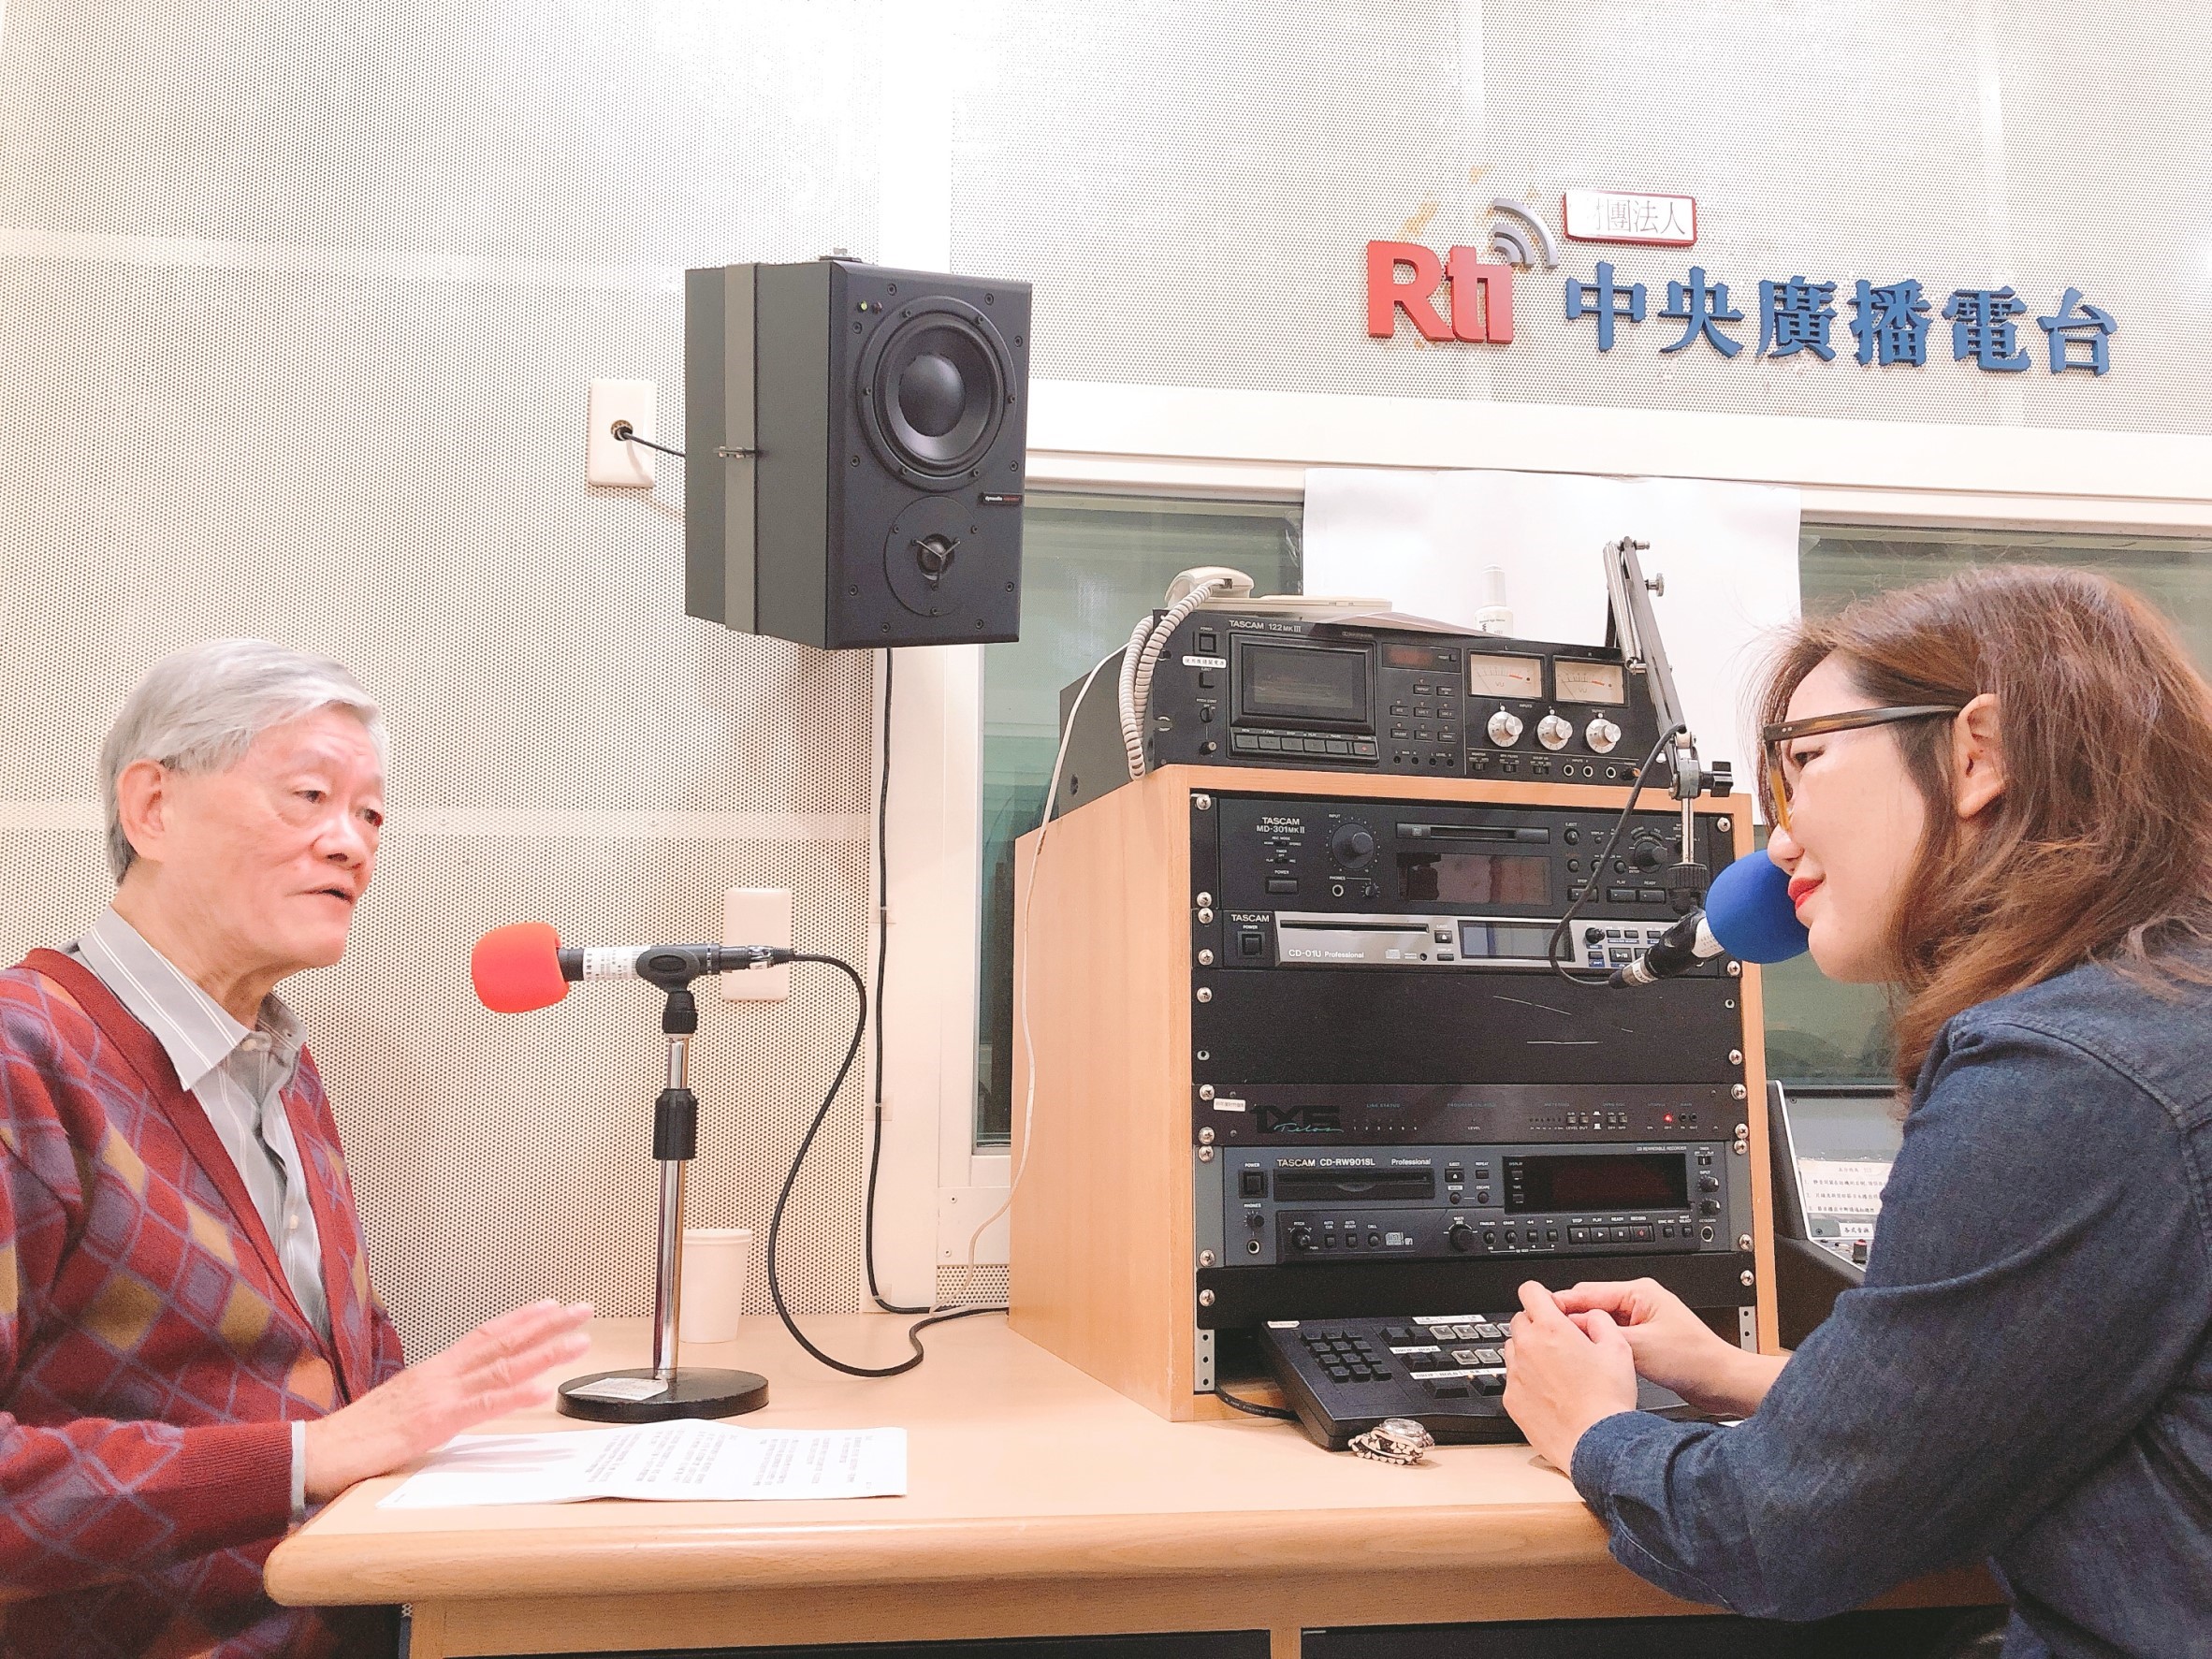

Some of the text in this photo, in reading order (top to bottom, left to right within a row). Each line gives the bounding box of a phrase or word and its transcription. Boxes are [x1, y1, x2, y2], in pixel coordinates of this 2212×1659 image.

[1367, 240, 1513, 344] Rti
[1565, 261, 2117, 376] 中央廣播電台
[1229, 619, 1265, 630] TASCAM
[1230, 914, 1270, 923] TASCAM
[1288, 949, 1364, 959] CD-01U Professional
[1276, 1158, 1375, 1167] TASCAM CD-RW901SL
